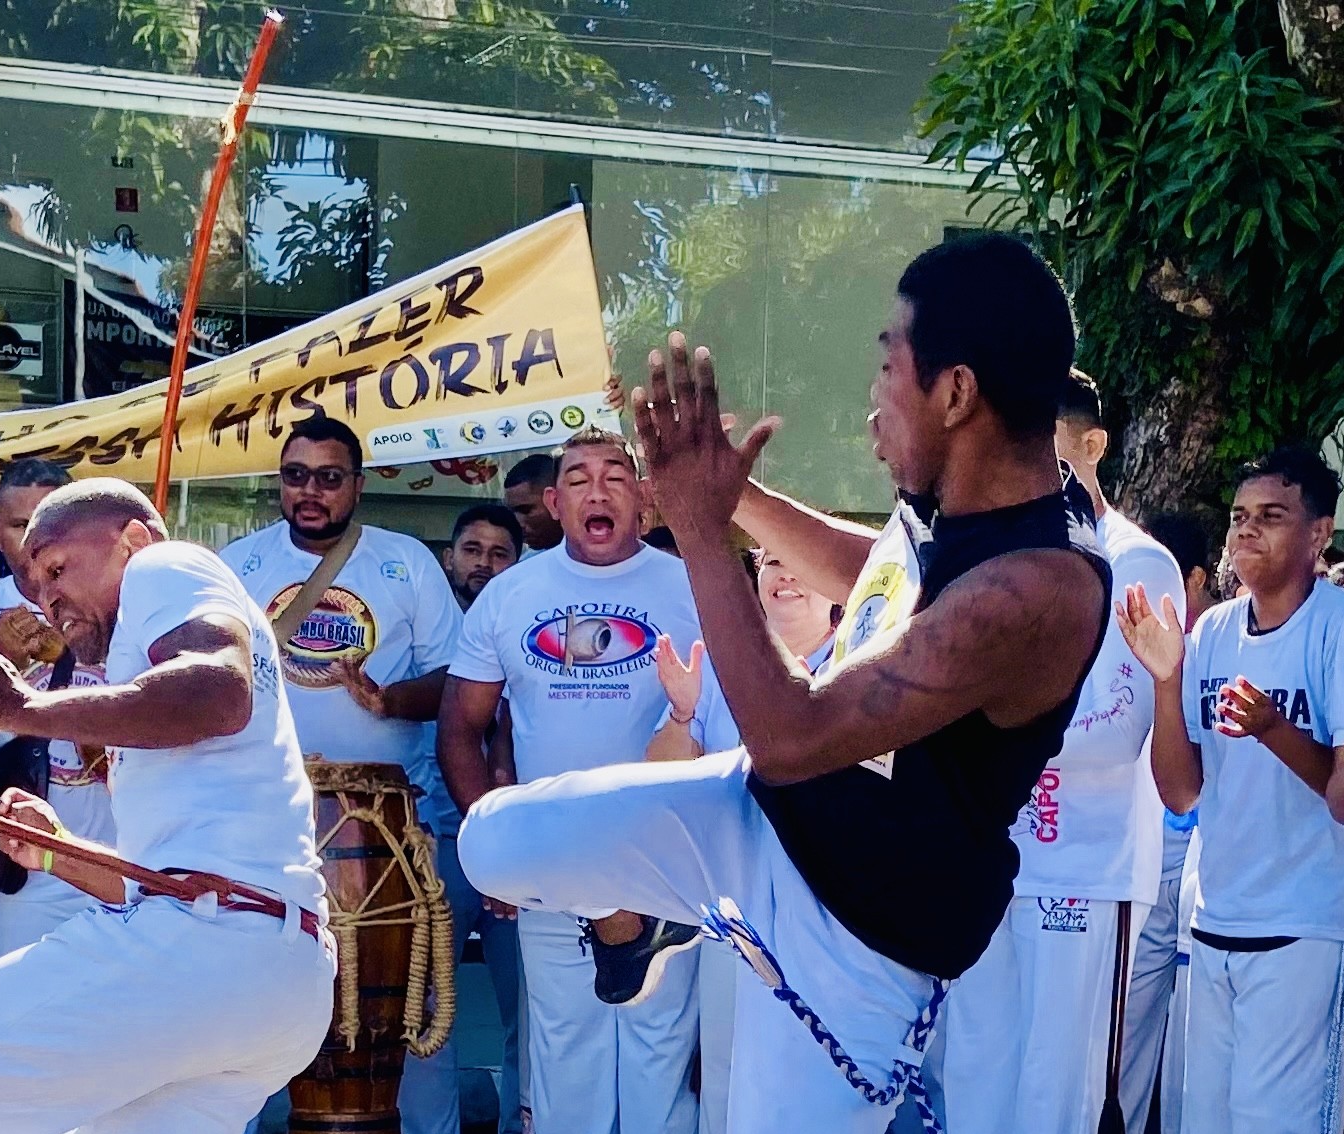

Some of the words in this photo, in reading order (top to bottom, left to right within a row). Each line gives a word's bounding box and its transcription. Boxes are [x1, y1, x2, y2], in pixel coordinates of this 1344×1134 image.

[209, 328, 564, 451] HISTÓRIA
[373, 432, 412, 446] APOIO
[535, 602, 650, 623] CAPOEIRA
[327, 623, 366, 649] BRASIL
[525, 653, 578, 679] ORIGEM
[582, 653, 657, 680] BRASILEIRA
[548, 691, 583, 700] MESTRE
[586, 691, 631, 701] ROBERTO
